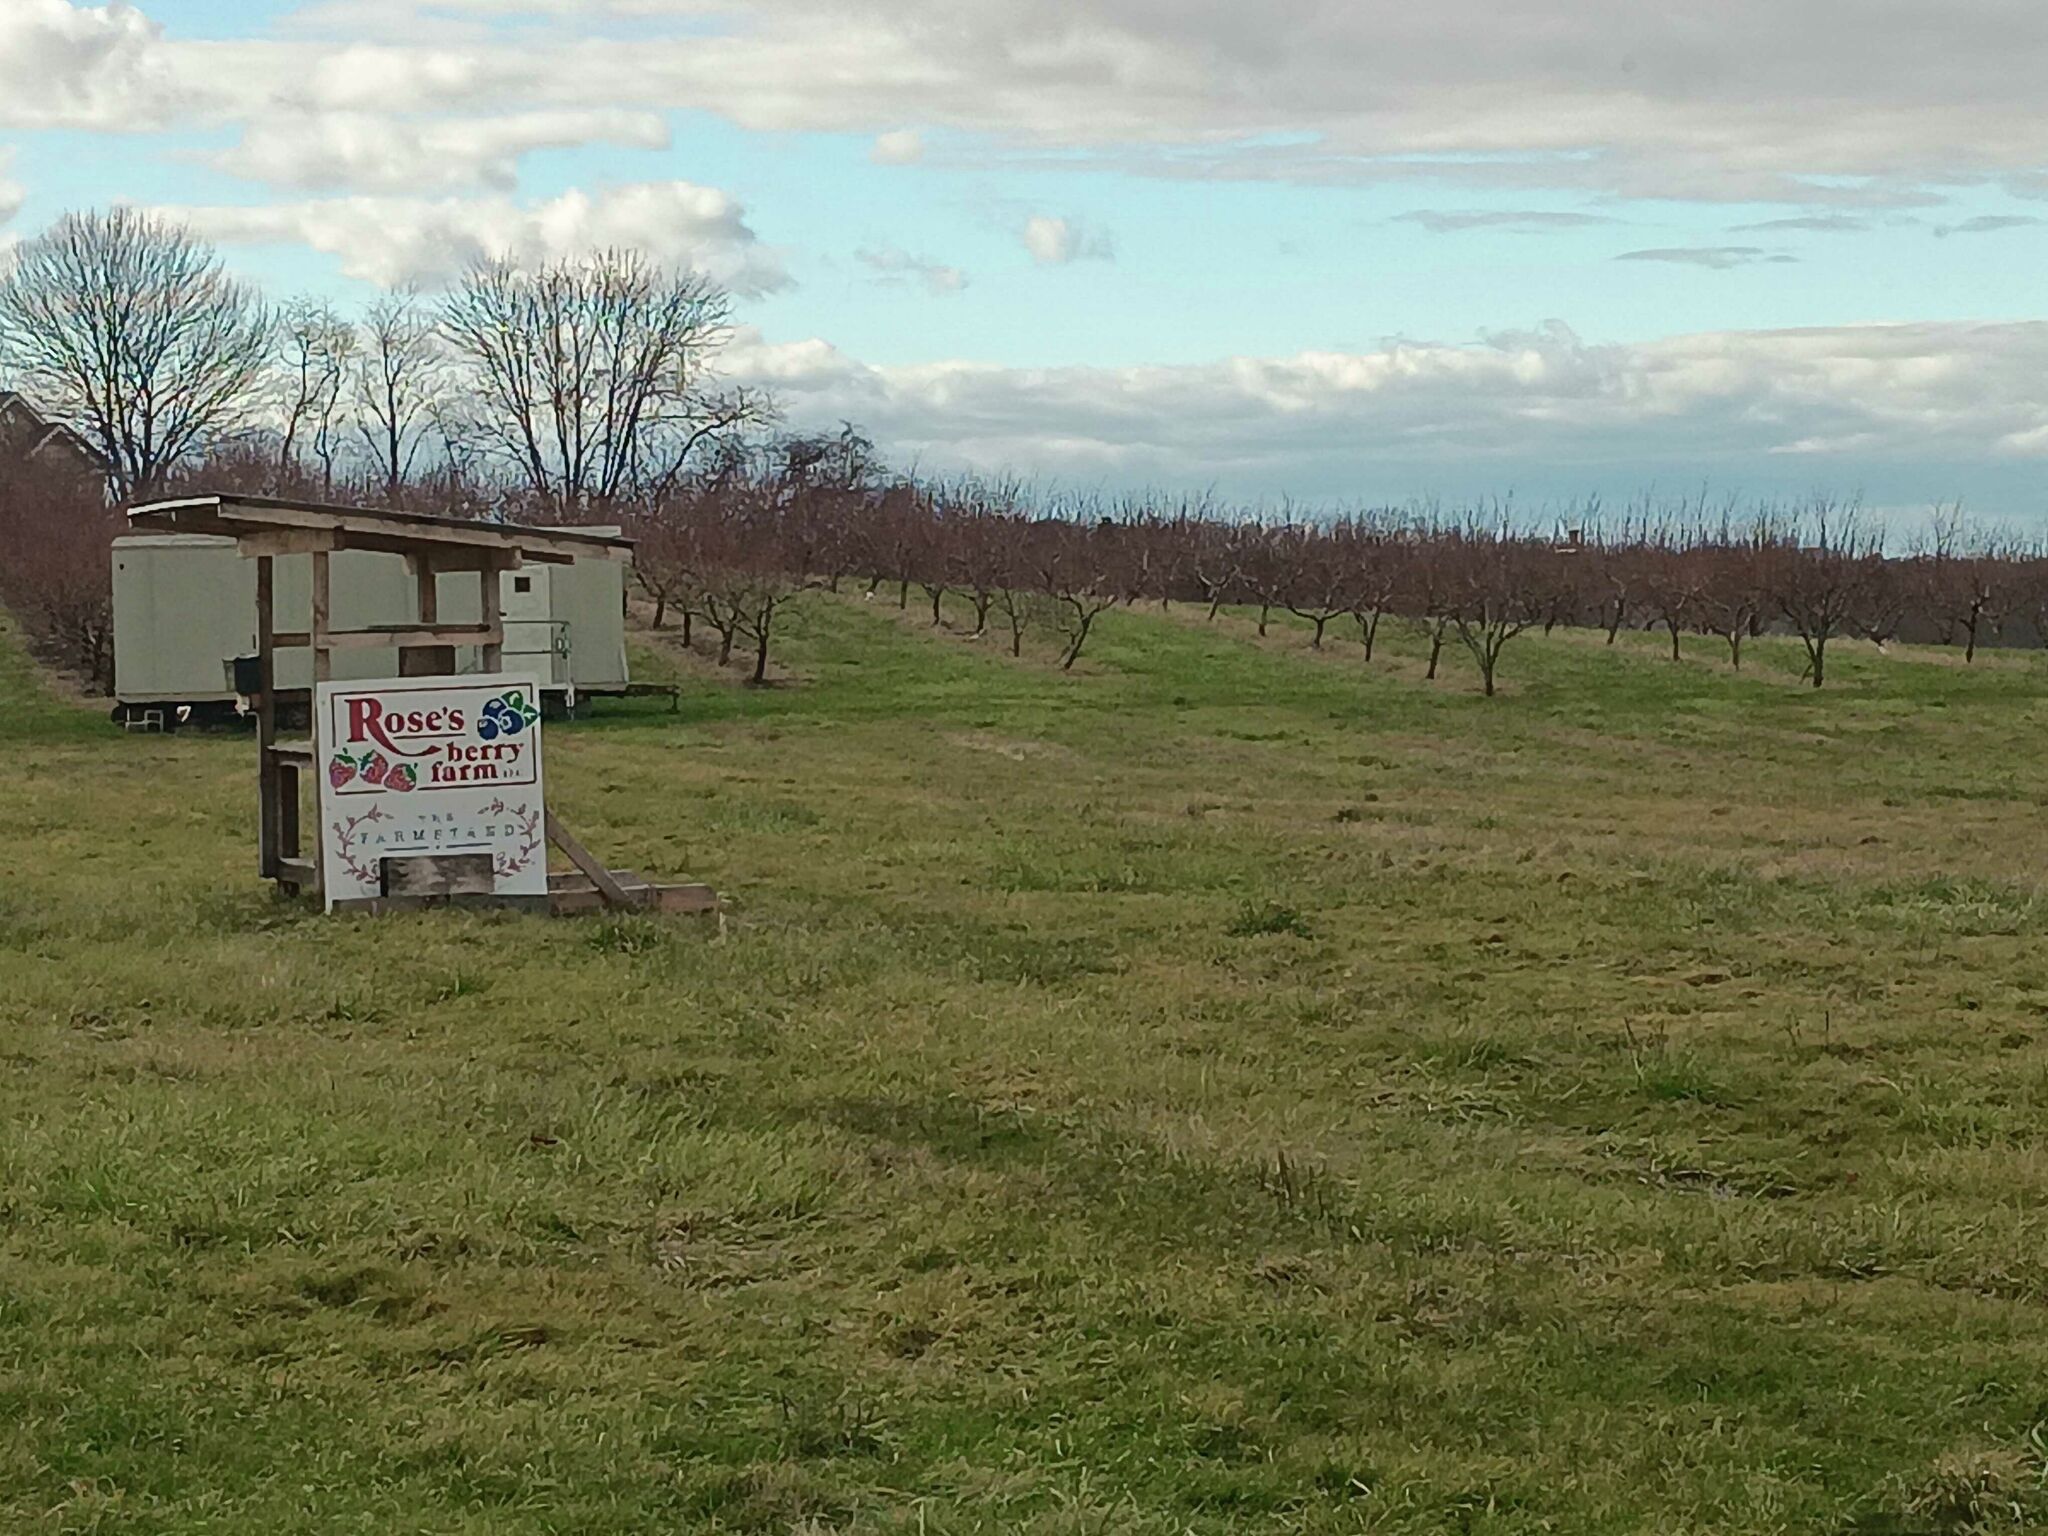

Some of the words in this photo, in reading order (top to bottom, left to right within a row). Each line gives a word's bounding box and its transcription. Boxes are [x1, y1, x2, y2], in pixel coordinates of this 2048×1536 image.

[344, 698, 465, 757] Rose's
[446, 741, 524, 763] berry
[431, 761, 498, 782] farm
